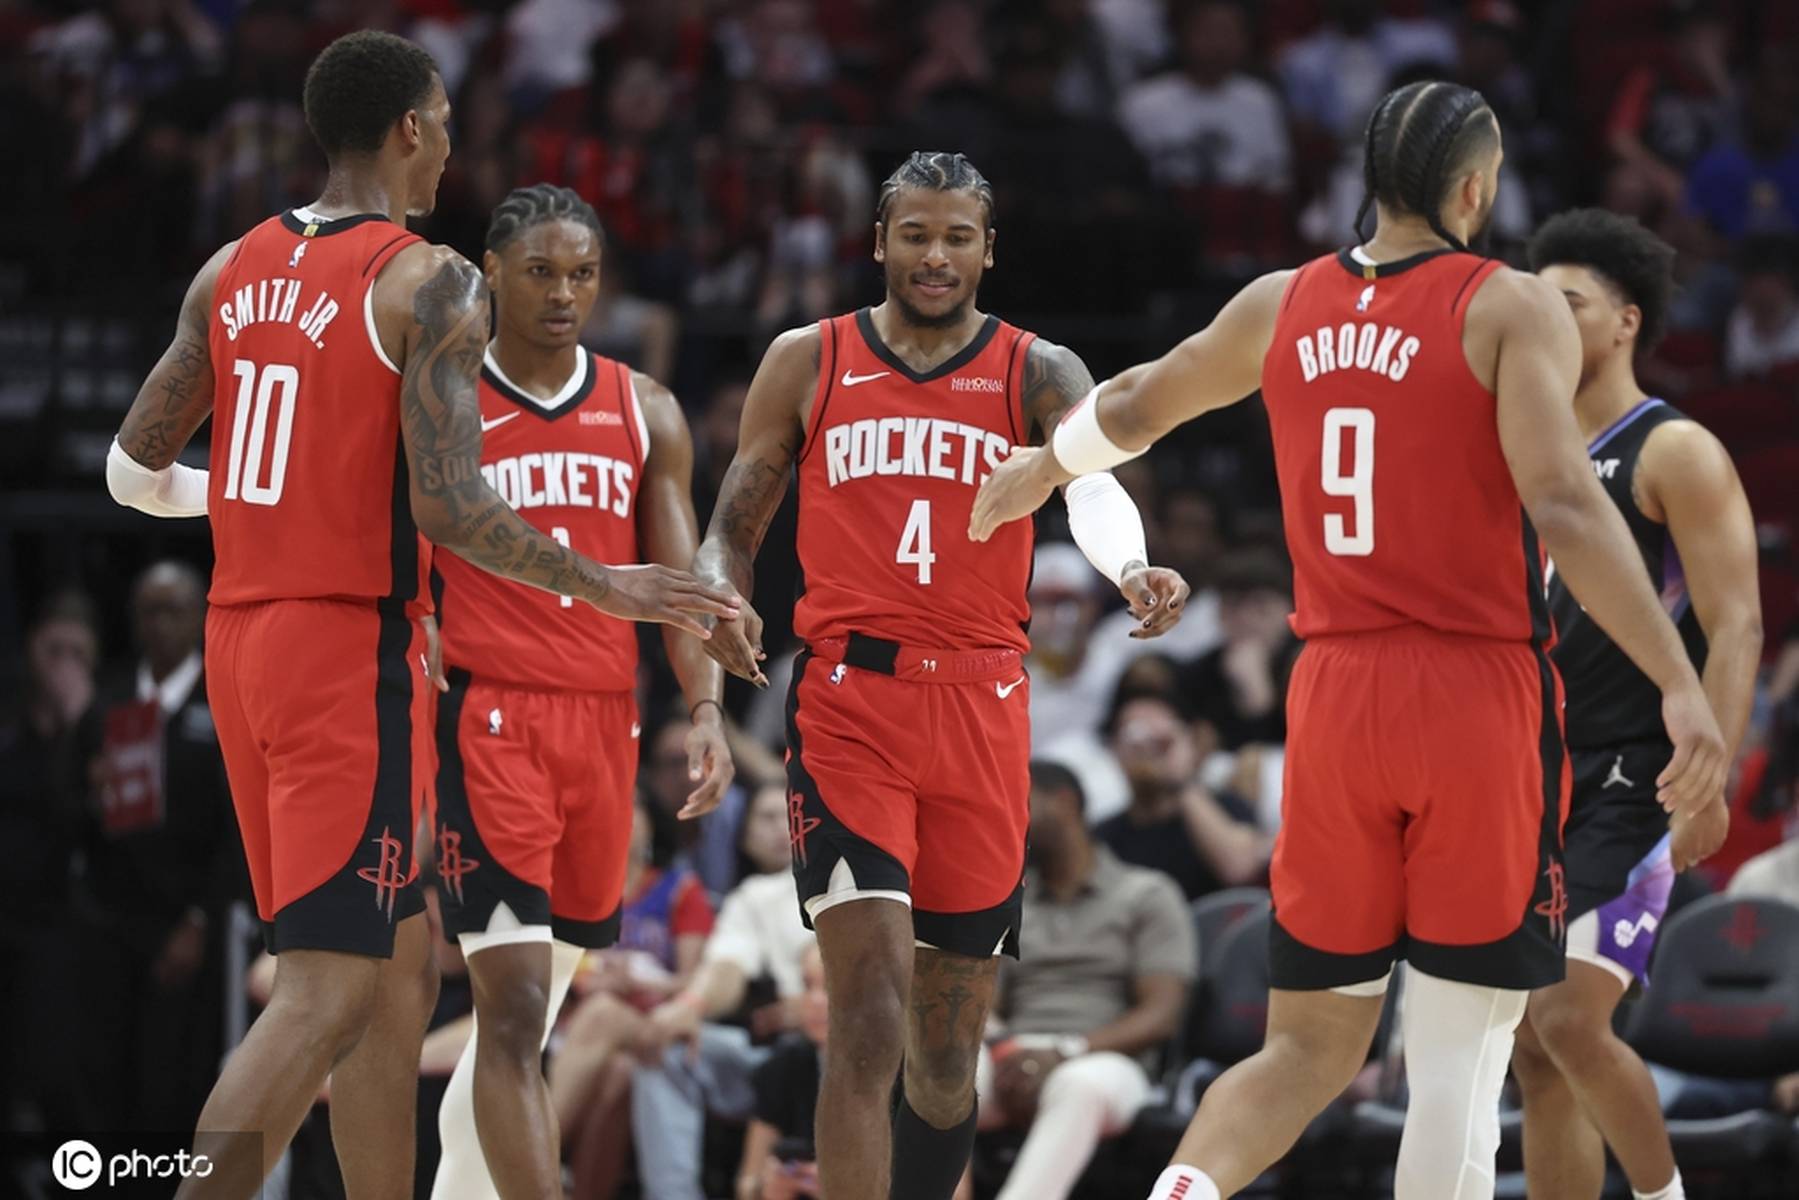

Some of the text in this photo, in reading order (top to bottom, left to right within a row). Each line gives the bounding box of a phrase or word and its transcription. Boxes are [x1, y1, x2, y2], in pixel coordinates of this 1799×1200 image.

[219, 278, 339, 350] SMITH JR.
[1296, 322, 1420, 383] BROOKS
[224, 358, 299, 507] 10
[825, 417, 1009, 488] ROCKETS
[480, 452, 633, 518] OCKETS
[1321, 407, 1375, 556] 9
[896, 499, 936, 584] 4
